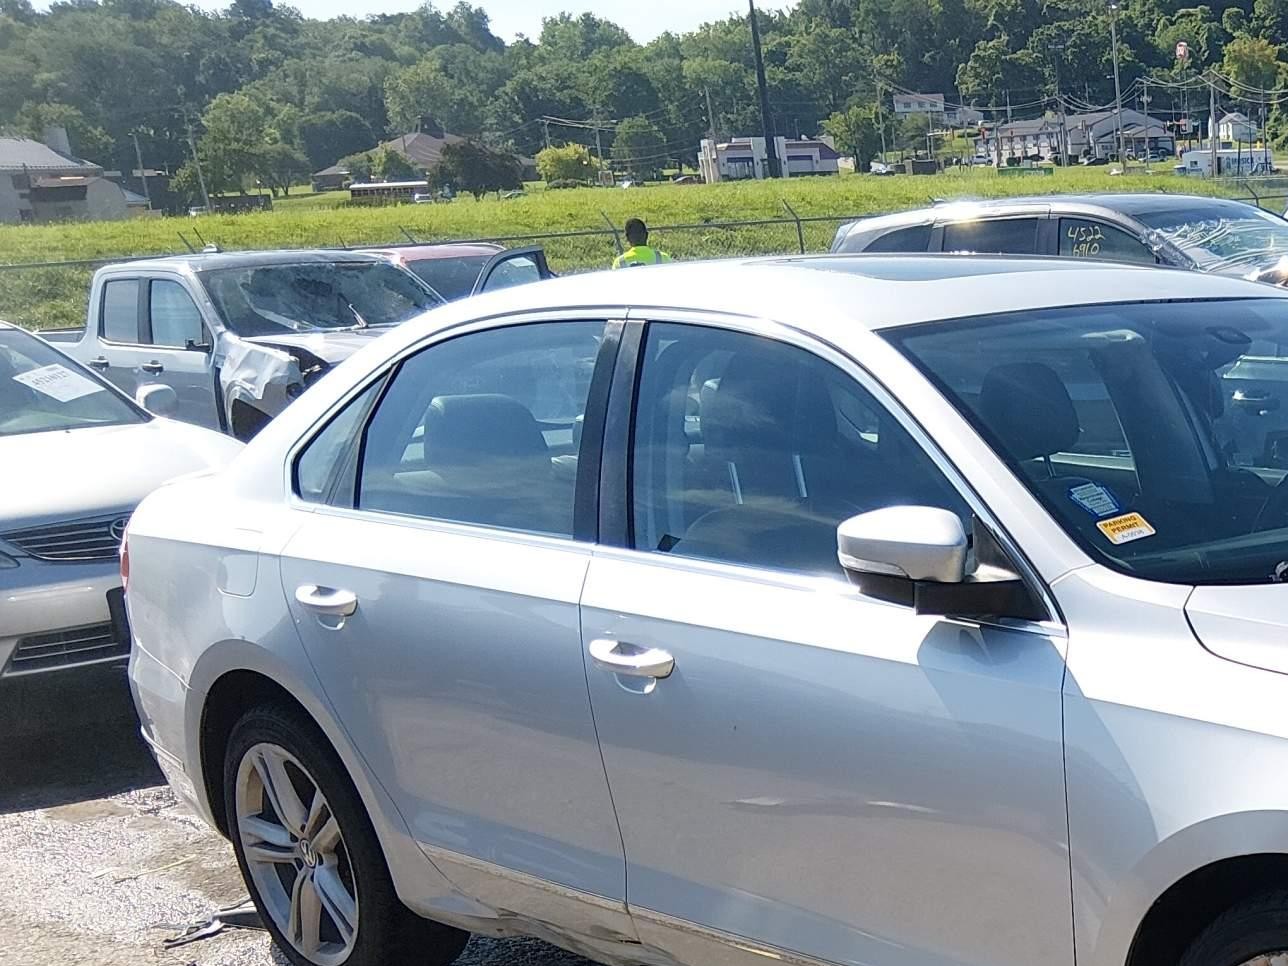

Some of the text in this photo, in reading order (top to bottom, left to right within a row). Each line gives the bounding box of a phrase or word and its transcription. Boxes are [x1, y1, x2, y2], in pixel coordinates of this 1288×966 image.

[1067, 226, 1105, 242] 4522
[1072, 243, 1099, 257] 6910
[1103, 515, 1137, 528] PARKING
[1111, 522, 1139, 533] PERMIT
